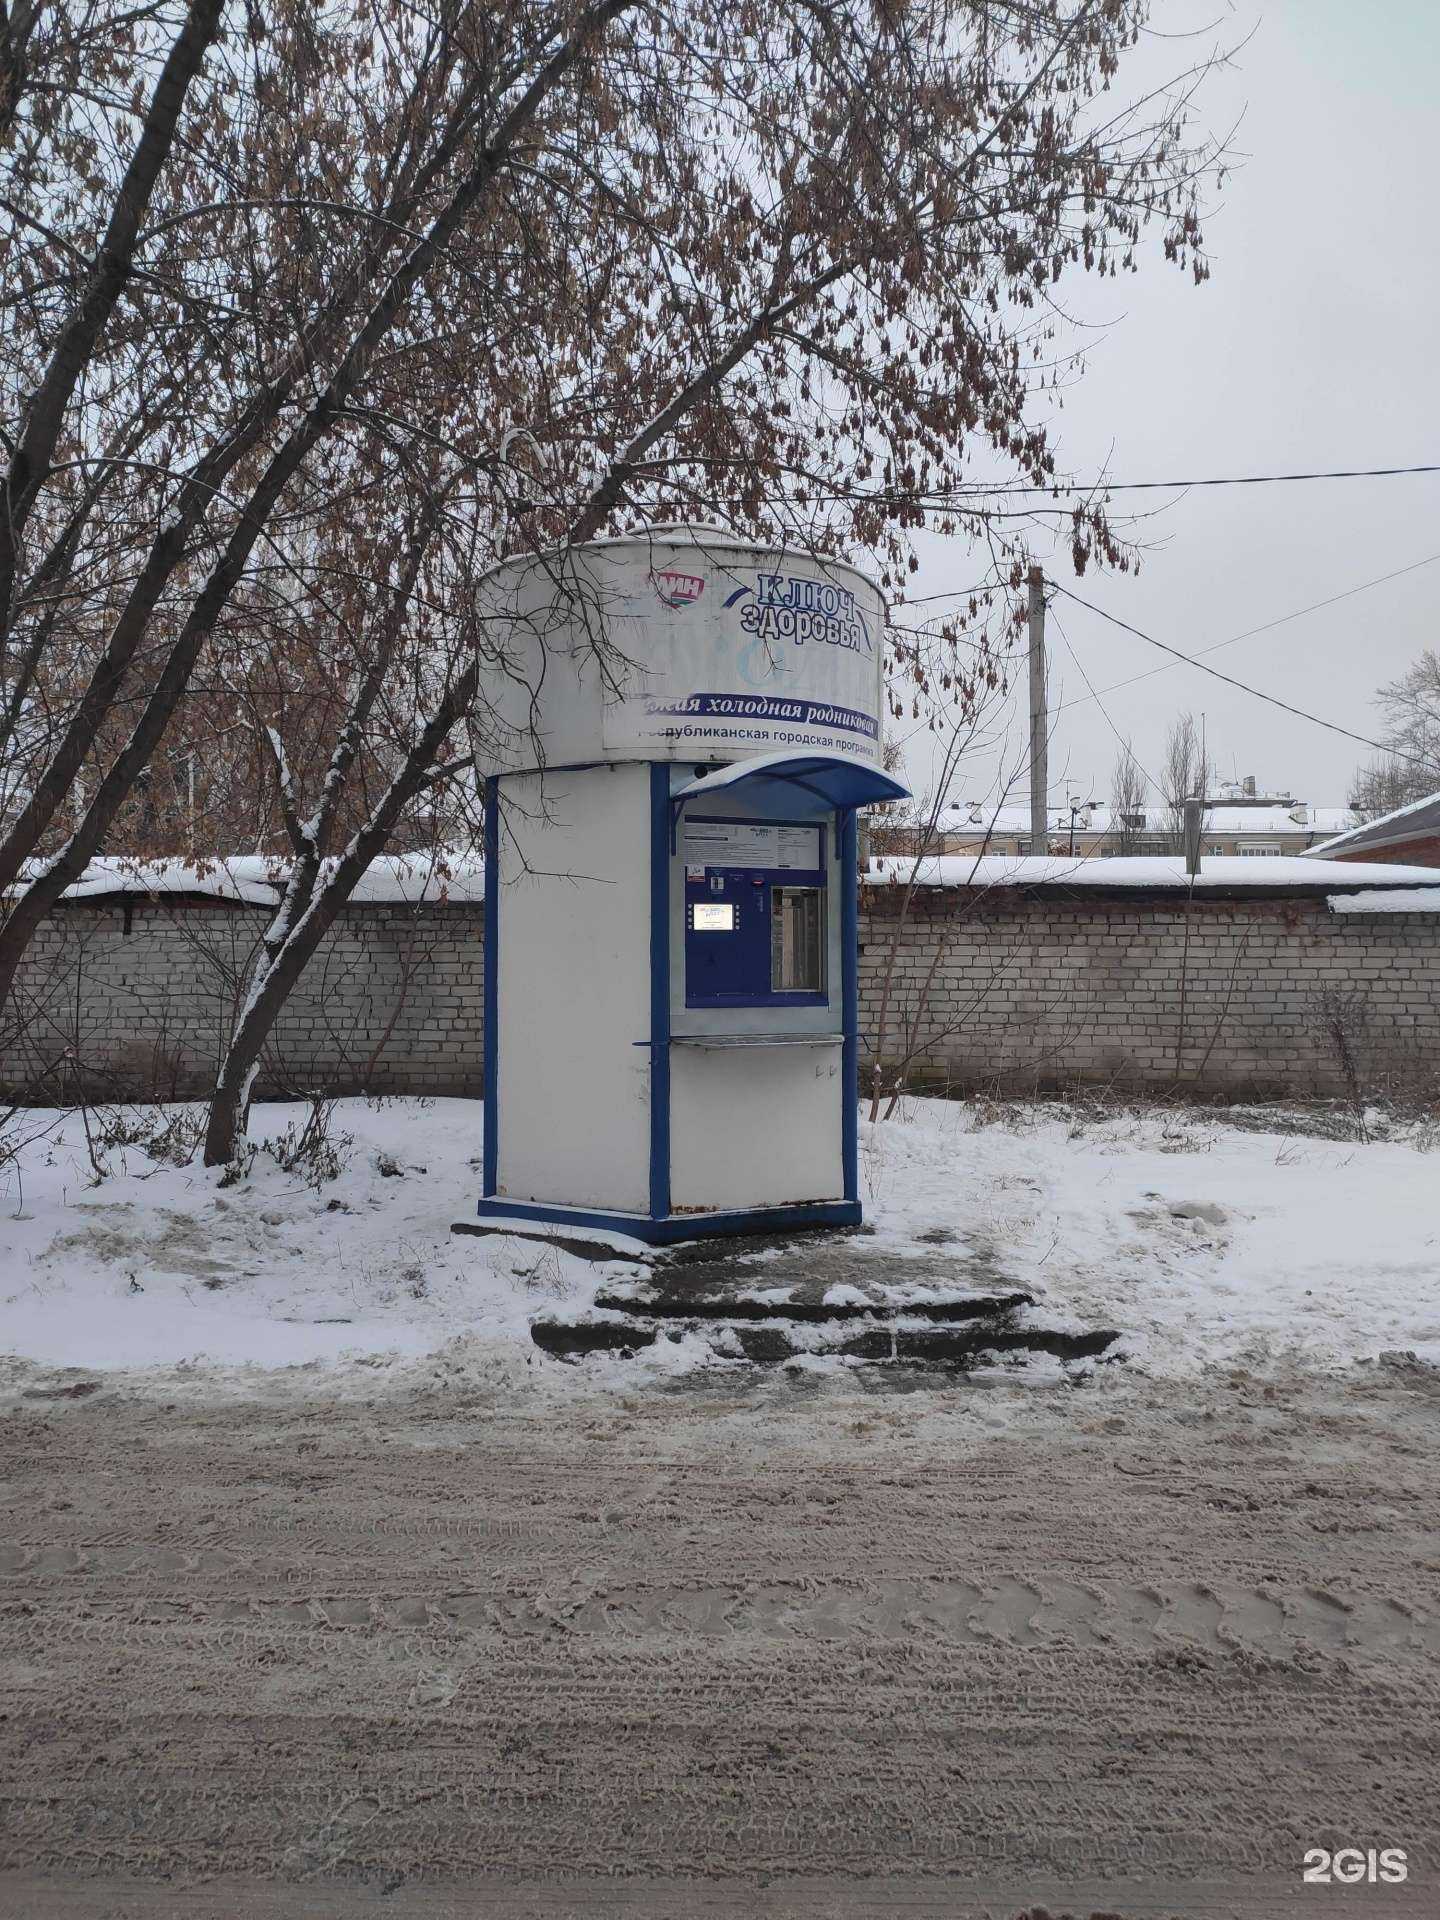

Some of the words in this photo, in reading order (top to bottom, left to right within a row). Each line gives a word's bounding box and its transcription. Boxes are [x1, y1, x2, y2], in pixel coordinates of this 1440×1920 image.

[757, 573, 855, 623] КЛЮЧ
[706, 696, 802, 718] холодная
[773, 730, 833, 748] городская
